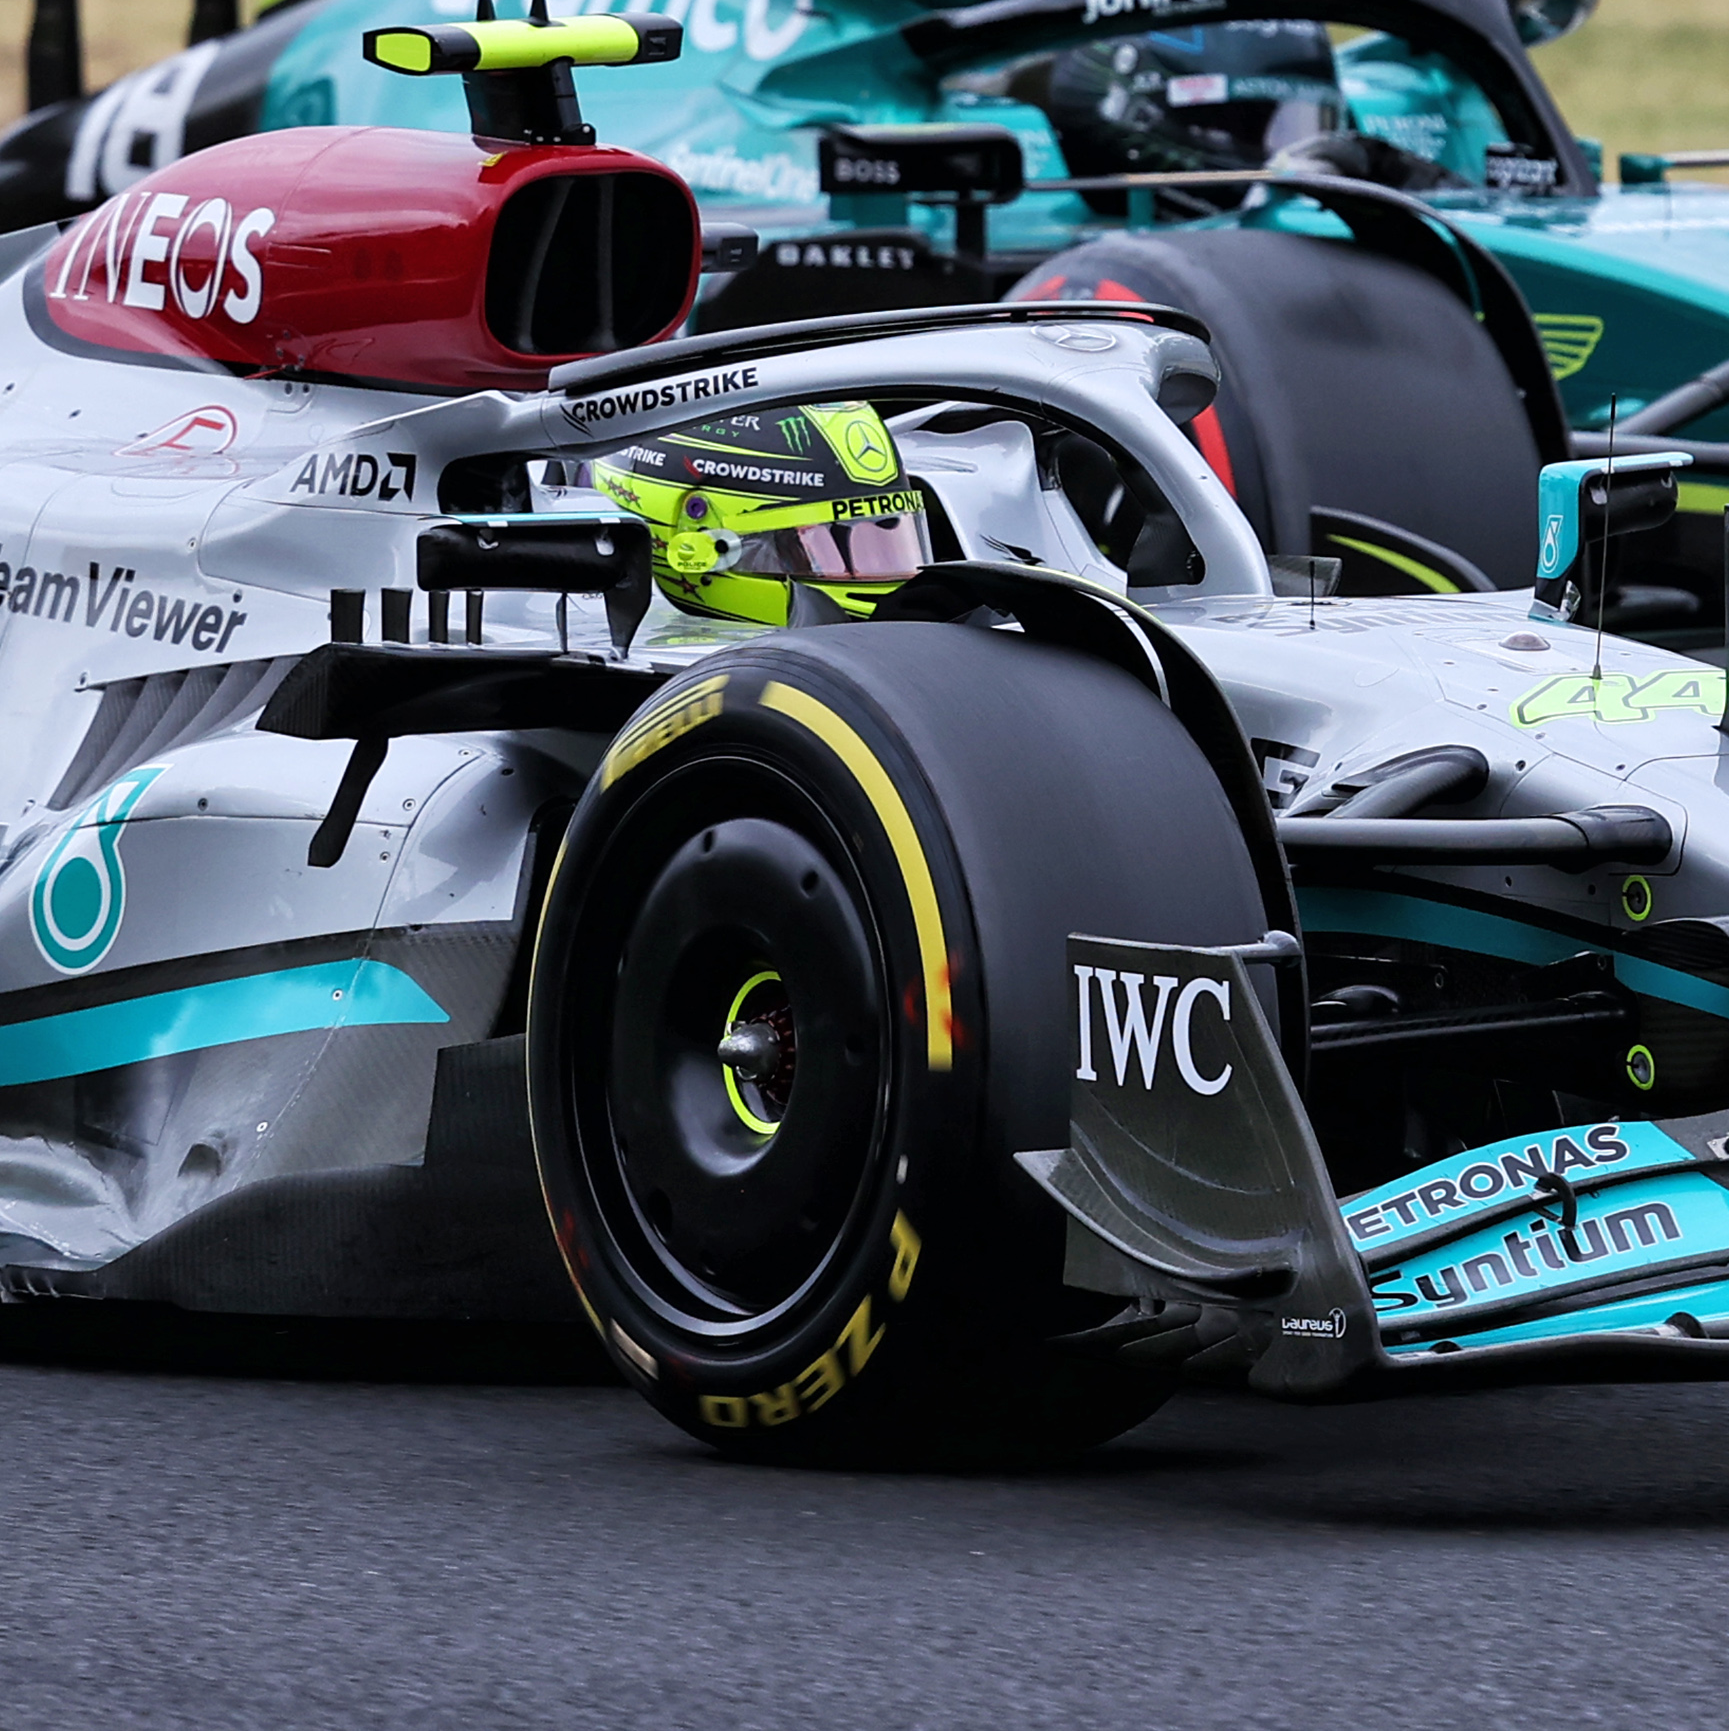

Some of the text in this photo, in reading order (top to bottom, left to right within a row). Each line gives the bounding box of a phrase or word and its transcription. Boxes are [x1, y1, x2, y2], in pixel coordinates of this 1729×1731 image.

[833, 156, 900, 187] BOSS
[49, 192, 276, 325] INEOS
[776, 242, 915, 270] OAKLEY
[572, 365, 760, 424] CROWDSTRIKE
[288, 453, 380, 497] AMD
[692, 458, 825, 488] CROWDSTRIKE
[831, 490, 923, 520] PETRONA
[1072, 964, 1234, 1097] IWC
[1344, 1124, 1629, 1242] ETRONAS
[1371, 1201, 1683, 1311] Syntium
[700, 1208, 922, 1428] P ZERO
